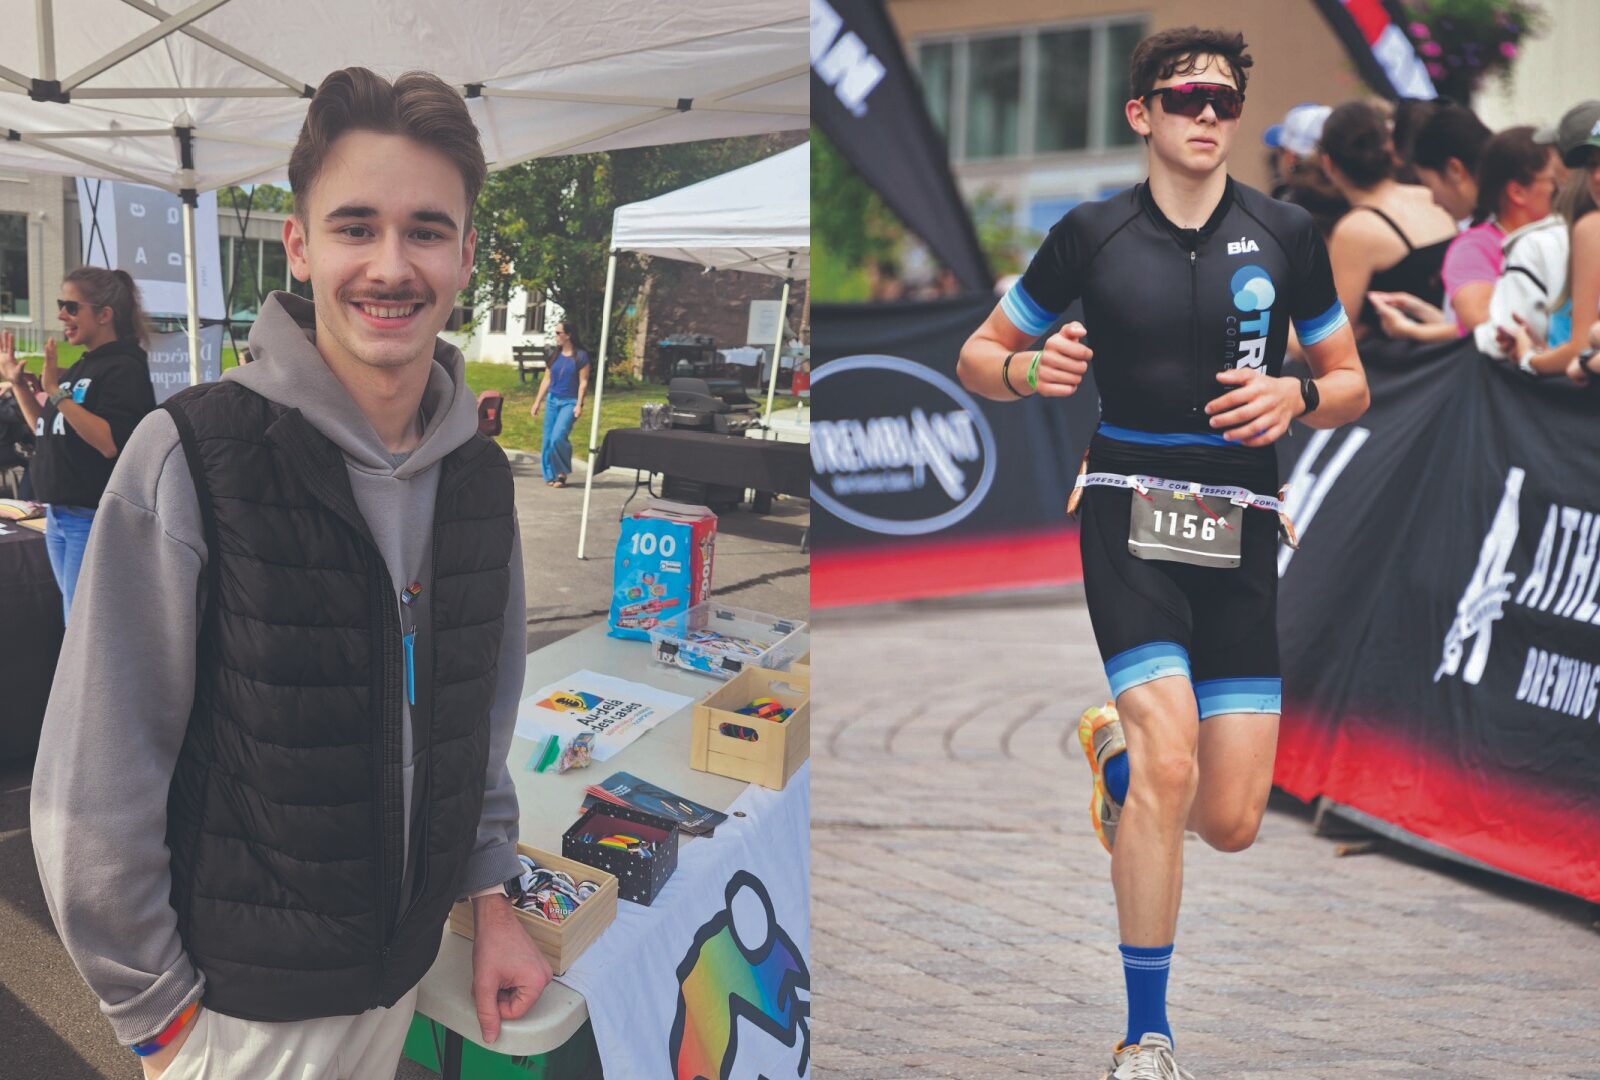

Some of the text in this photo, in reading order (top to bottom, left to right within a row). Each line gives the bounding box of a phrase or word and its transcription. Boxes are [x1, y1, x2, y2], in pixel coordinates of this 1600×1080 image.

[1153, 510, 1216, 541] 1156
[631, 532, 676, 557] 100
[1516, 503, 1600, 626] ATHL
